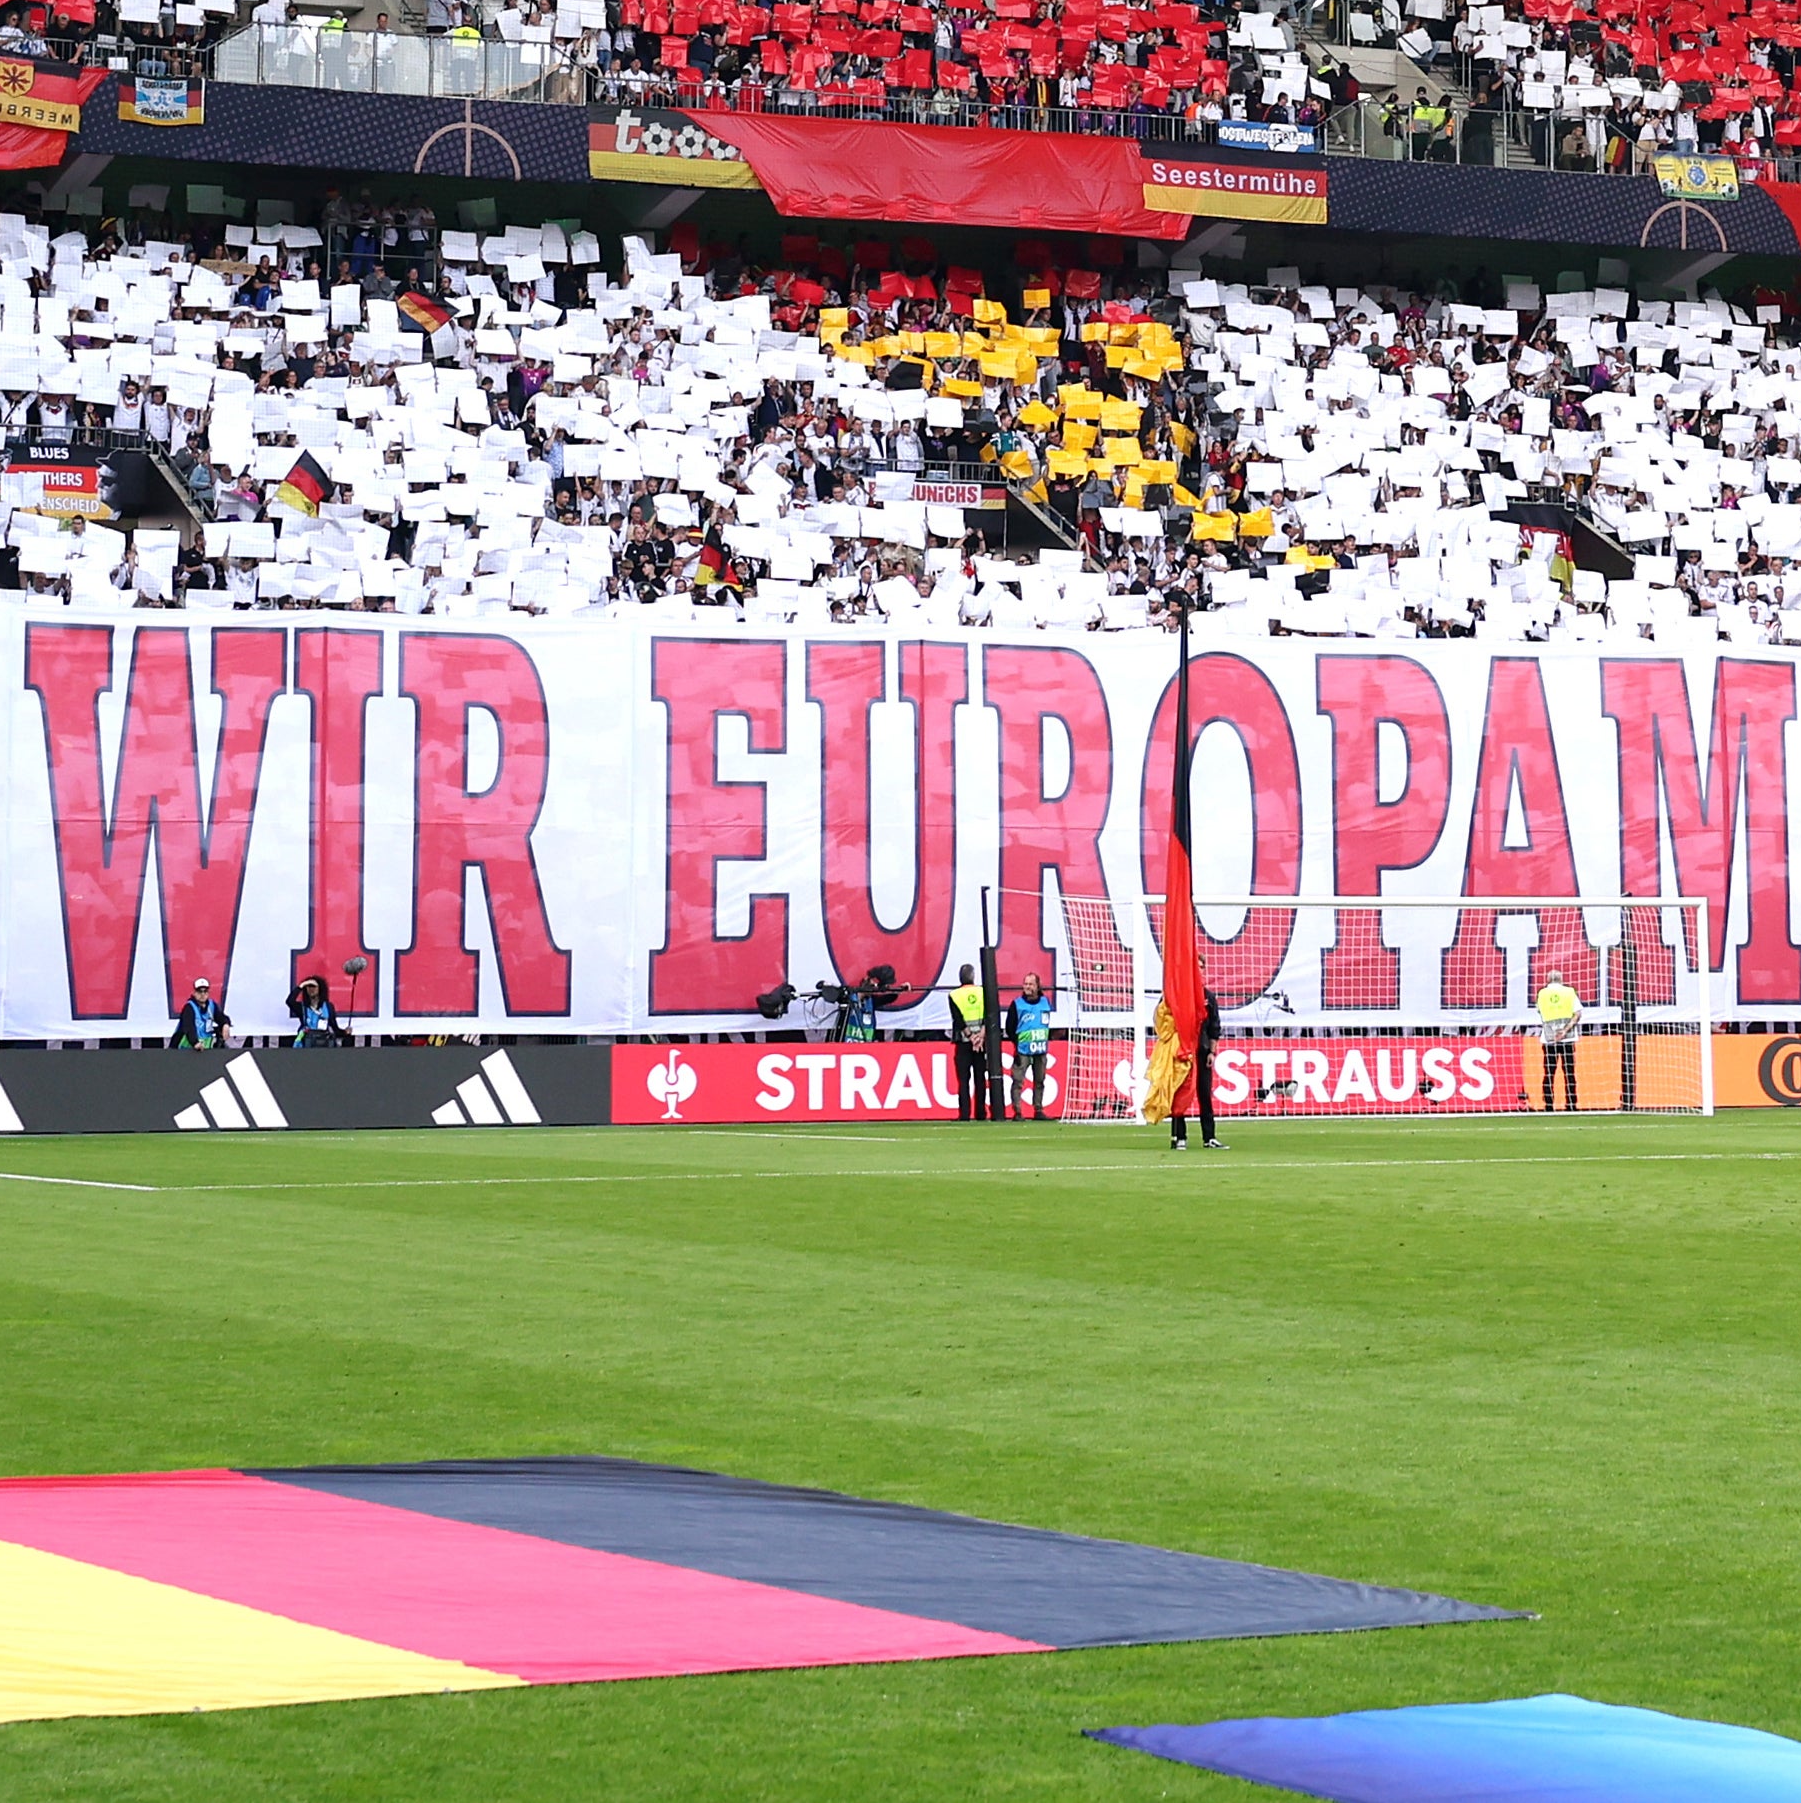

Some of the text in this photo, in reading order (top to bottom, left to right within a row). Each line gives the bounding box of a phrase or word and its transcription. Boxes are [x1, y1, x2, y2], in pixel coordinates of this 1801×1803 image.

[1151, 162, 1317, 195] Seestermühe
[29, 446, 70, 460] BLUES
[23, 621, 573, 1021] WIR
[1213, 1045, 1496, 1105] STRAUSS
